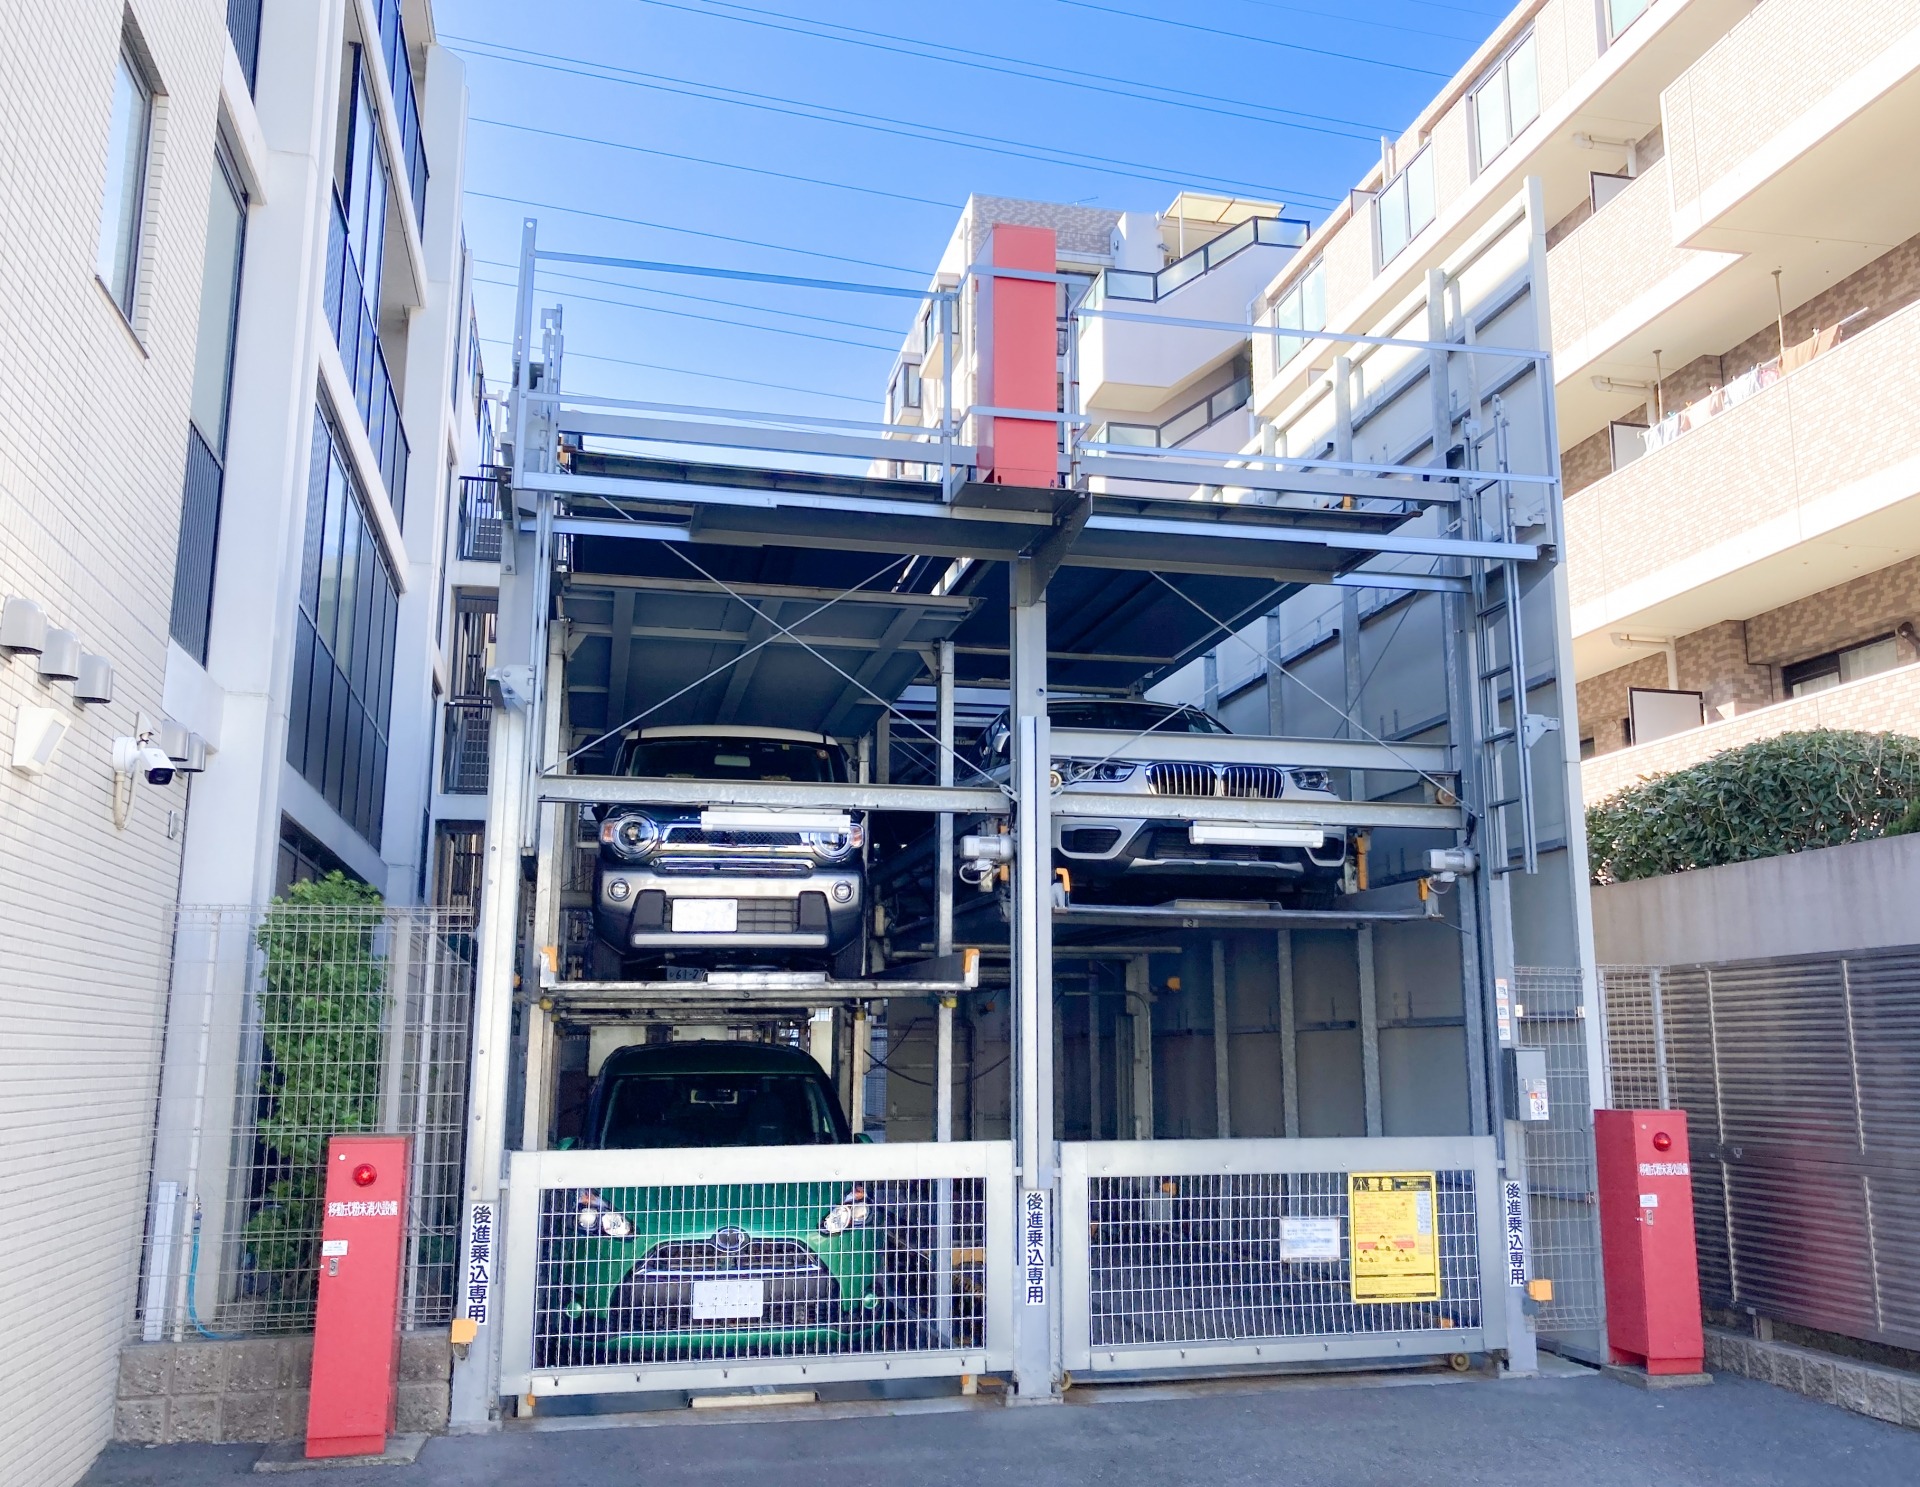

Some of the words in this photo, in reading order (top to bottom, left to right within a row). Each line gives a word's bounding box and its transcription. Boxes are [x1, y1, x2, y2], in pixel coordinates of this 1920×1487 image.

[327, 1200, 398, 1217] 移動式粉末消火設備
[1026, 1192, 1044, 1304] 後進乗込専用
[1505, 1182, 1524, 1286] 後進乗込専用
[467, 1205, 492, 1323] 後進乗込専用
